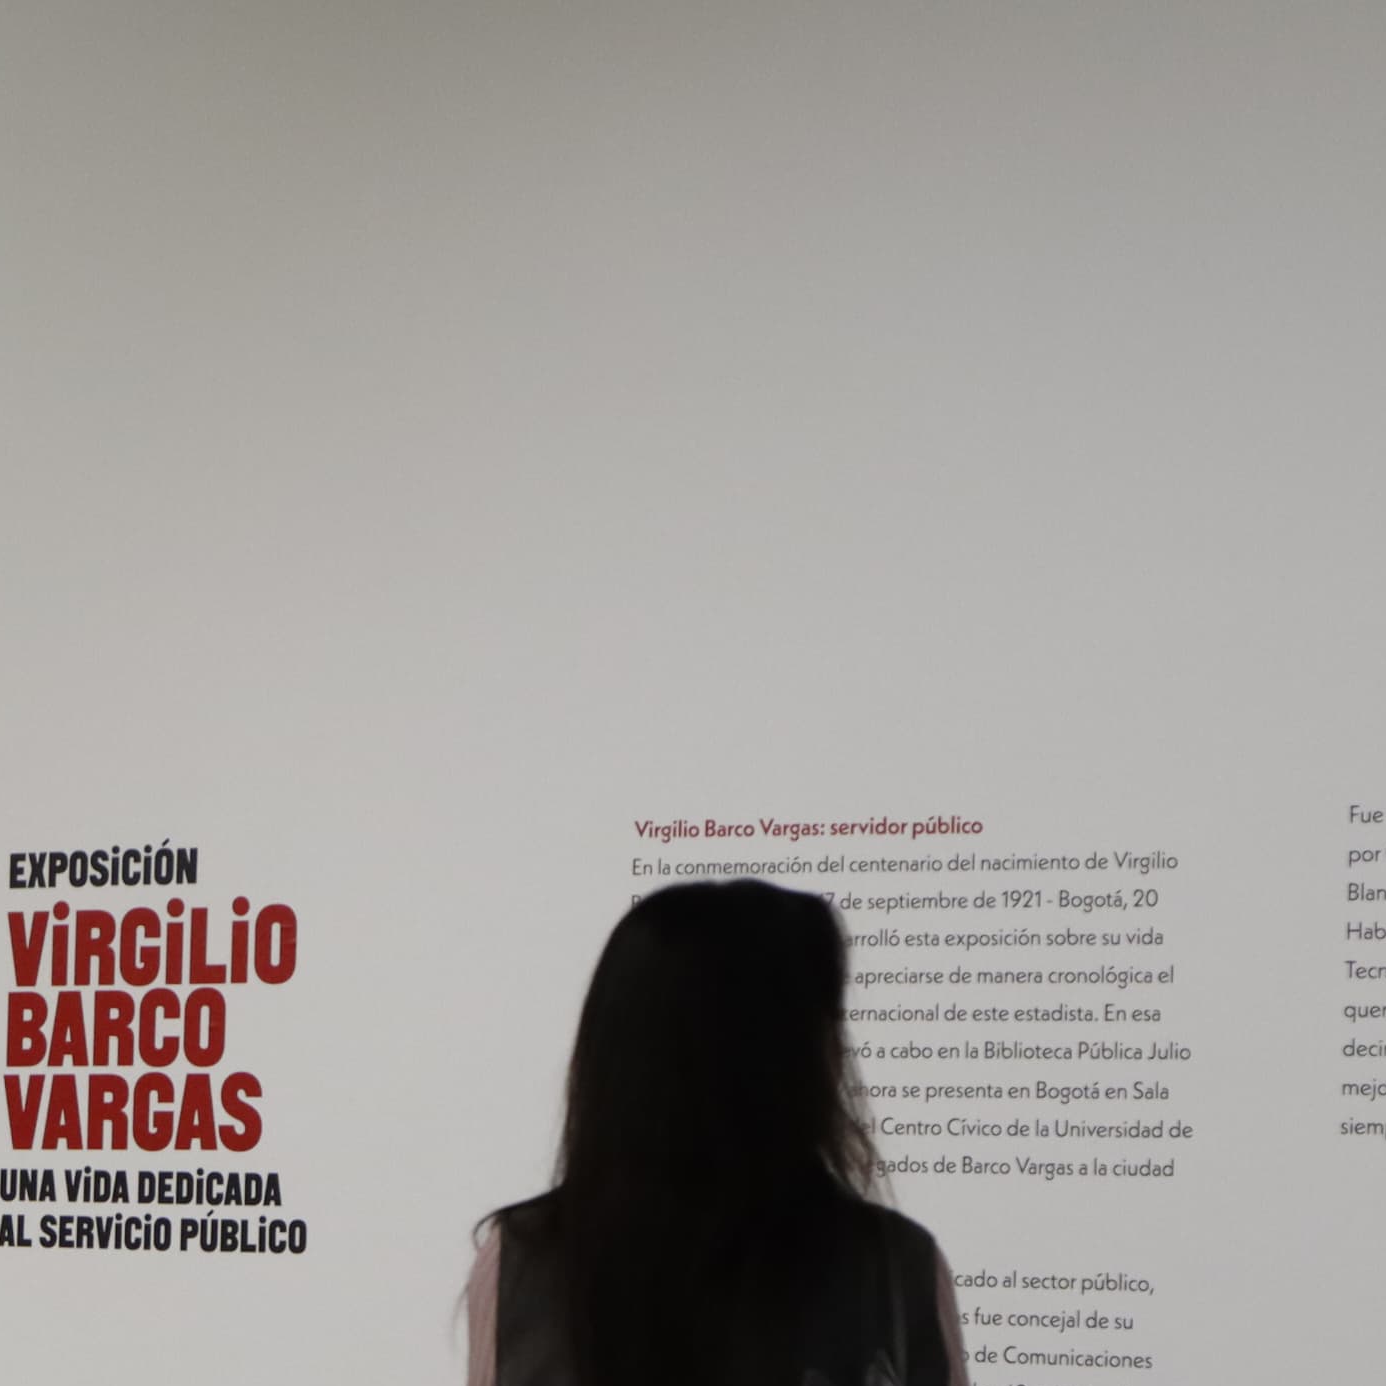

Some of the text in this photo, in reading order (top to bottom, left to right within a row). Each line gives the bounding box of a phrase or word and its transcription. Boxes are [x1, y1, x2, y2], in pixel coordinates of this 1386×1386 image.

[1349, 804, 1384, 824] Fue
[634, 815, 983, 843] Virgilio Barco Vargas: servidor público
[631, 850, 1179, 876] En la conmemoración del centenario del nacimiento de Virgilio
[839, 892, 863, 910] de
[867, 890, 968, 915] septiembre
[972, 890, 996, 909] de
[1001, 889, 1041, 908] 1921
[1058, 889, 1128, 913] Bogotá,
[1132, 888, 1159, 908] 20
[904, 931, 940, 947] esta
[943, 927, 1041, 951] exposición
[1046, 927, 1097, 946] sobre
[1101, 932, 1121, 946] su
[1125, 926, 1164, 946] vida
[854, 966, 944, 989] apreciarse
[948, 965, 972, 984] de
[976, 971, 1043, 984] manera
[1047, 964, 1153, 990] cronológica
[1156, 964, 1174, 984] el
[943, 1002, 968, 1022] de
[971, 1007, 1009, 1022] este
[1013, 1002, 1099, 1022] estadista.
[1103, 1002, 1127, 1022] En
[1130, 1008, 1161, 1022] esa
[6, 986, 226, 1067] BARCO
[875, 1046, 885, 1059] a
[889, 1040, 933, 1059] cabo
[937, 1046, 960, 1059] en
[964, 1040, 979, 1059] la
[983, 1040, 1073, 1060] Biblioteca
[1077, 1040, 1143, 1060] Pública
[1146, 1041, 1191, 1061] Julio
[901, 1085, 921, 1098] se
[925, 1084, 1003, 1104] presenta
[1007, 1086, 1030, 1099] en
[1035, 1080, 1100, 1105] Bogotá
[1104, 1087, 1128, 1100] en
[1132, 1080, 1169, 1100] Sala
[4, 1072, 262, 1152] VARGAS
[880, 1116, 942, 1136] Centro
[946, 1117, 1002, 1137] Cívico
[1006, 1118, 1030, 1137] de
[1035, 1118, 1049, 1138] la
[1054, 1119, 1164, 1139] Universidad
[1168, 1119, 1193, 1139] de
[932, 1154, 957, 1174] de
[961, 1155, 1011, 1175] Barco
[1015, 1156, 1074, 1181] Vargas
[1078, 1163, 1088, 1176] a
[1093, 1157, 1108, 1176] la
[1112, 1157, 1174, 1177] ciudad
[0, 1169, 56, 1202] UNA
[1002, 1269, 1017, 1288] al
[1021, 1274, 1077, 1290] sector
[1080, 1272, 1154, 1296] público,
[973, 1306, 1003, 1326] fue
[1007, 1309, 1080, 1333] concejal
[1084, 1309, 1109, 1329] de
[1114, 1316, 1134, 1330] su
[974, 1344, 998, 1364] de
[1002, 1345, 1153, 1369] Comunicaciones
